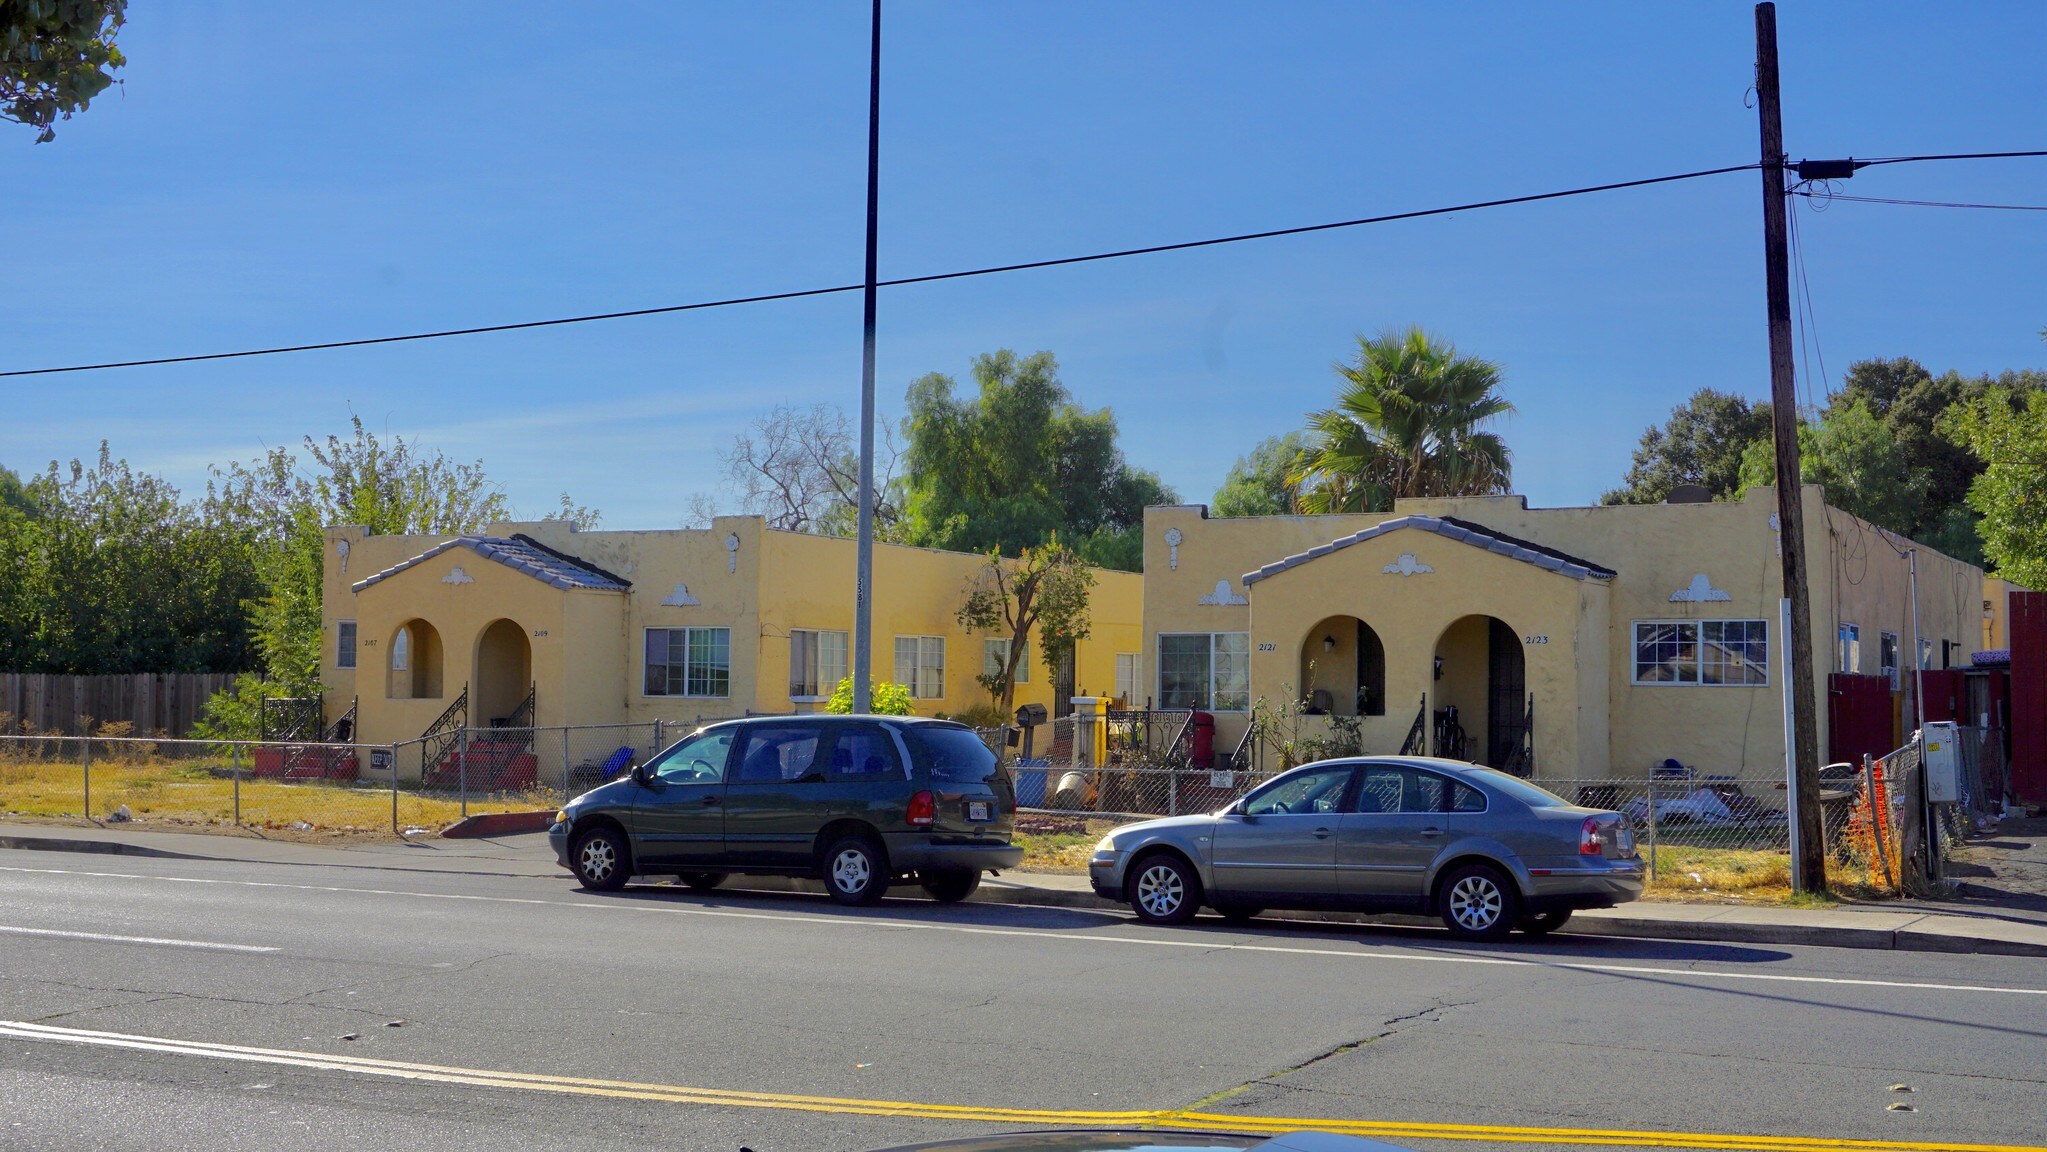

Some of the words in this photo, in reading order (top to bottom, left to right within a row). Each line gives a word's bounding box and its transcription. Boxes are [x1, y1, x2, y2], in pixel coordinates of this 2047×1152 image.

[1525, 635, 1549, 645] 2123
[1258, 643, 1277, 651] 2121
[371, 753, 382, 765] KEEP
